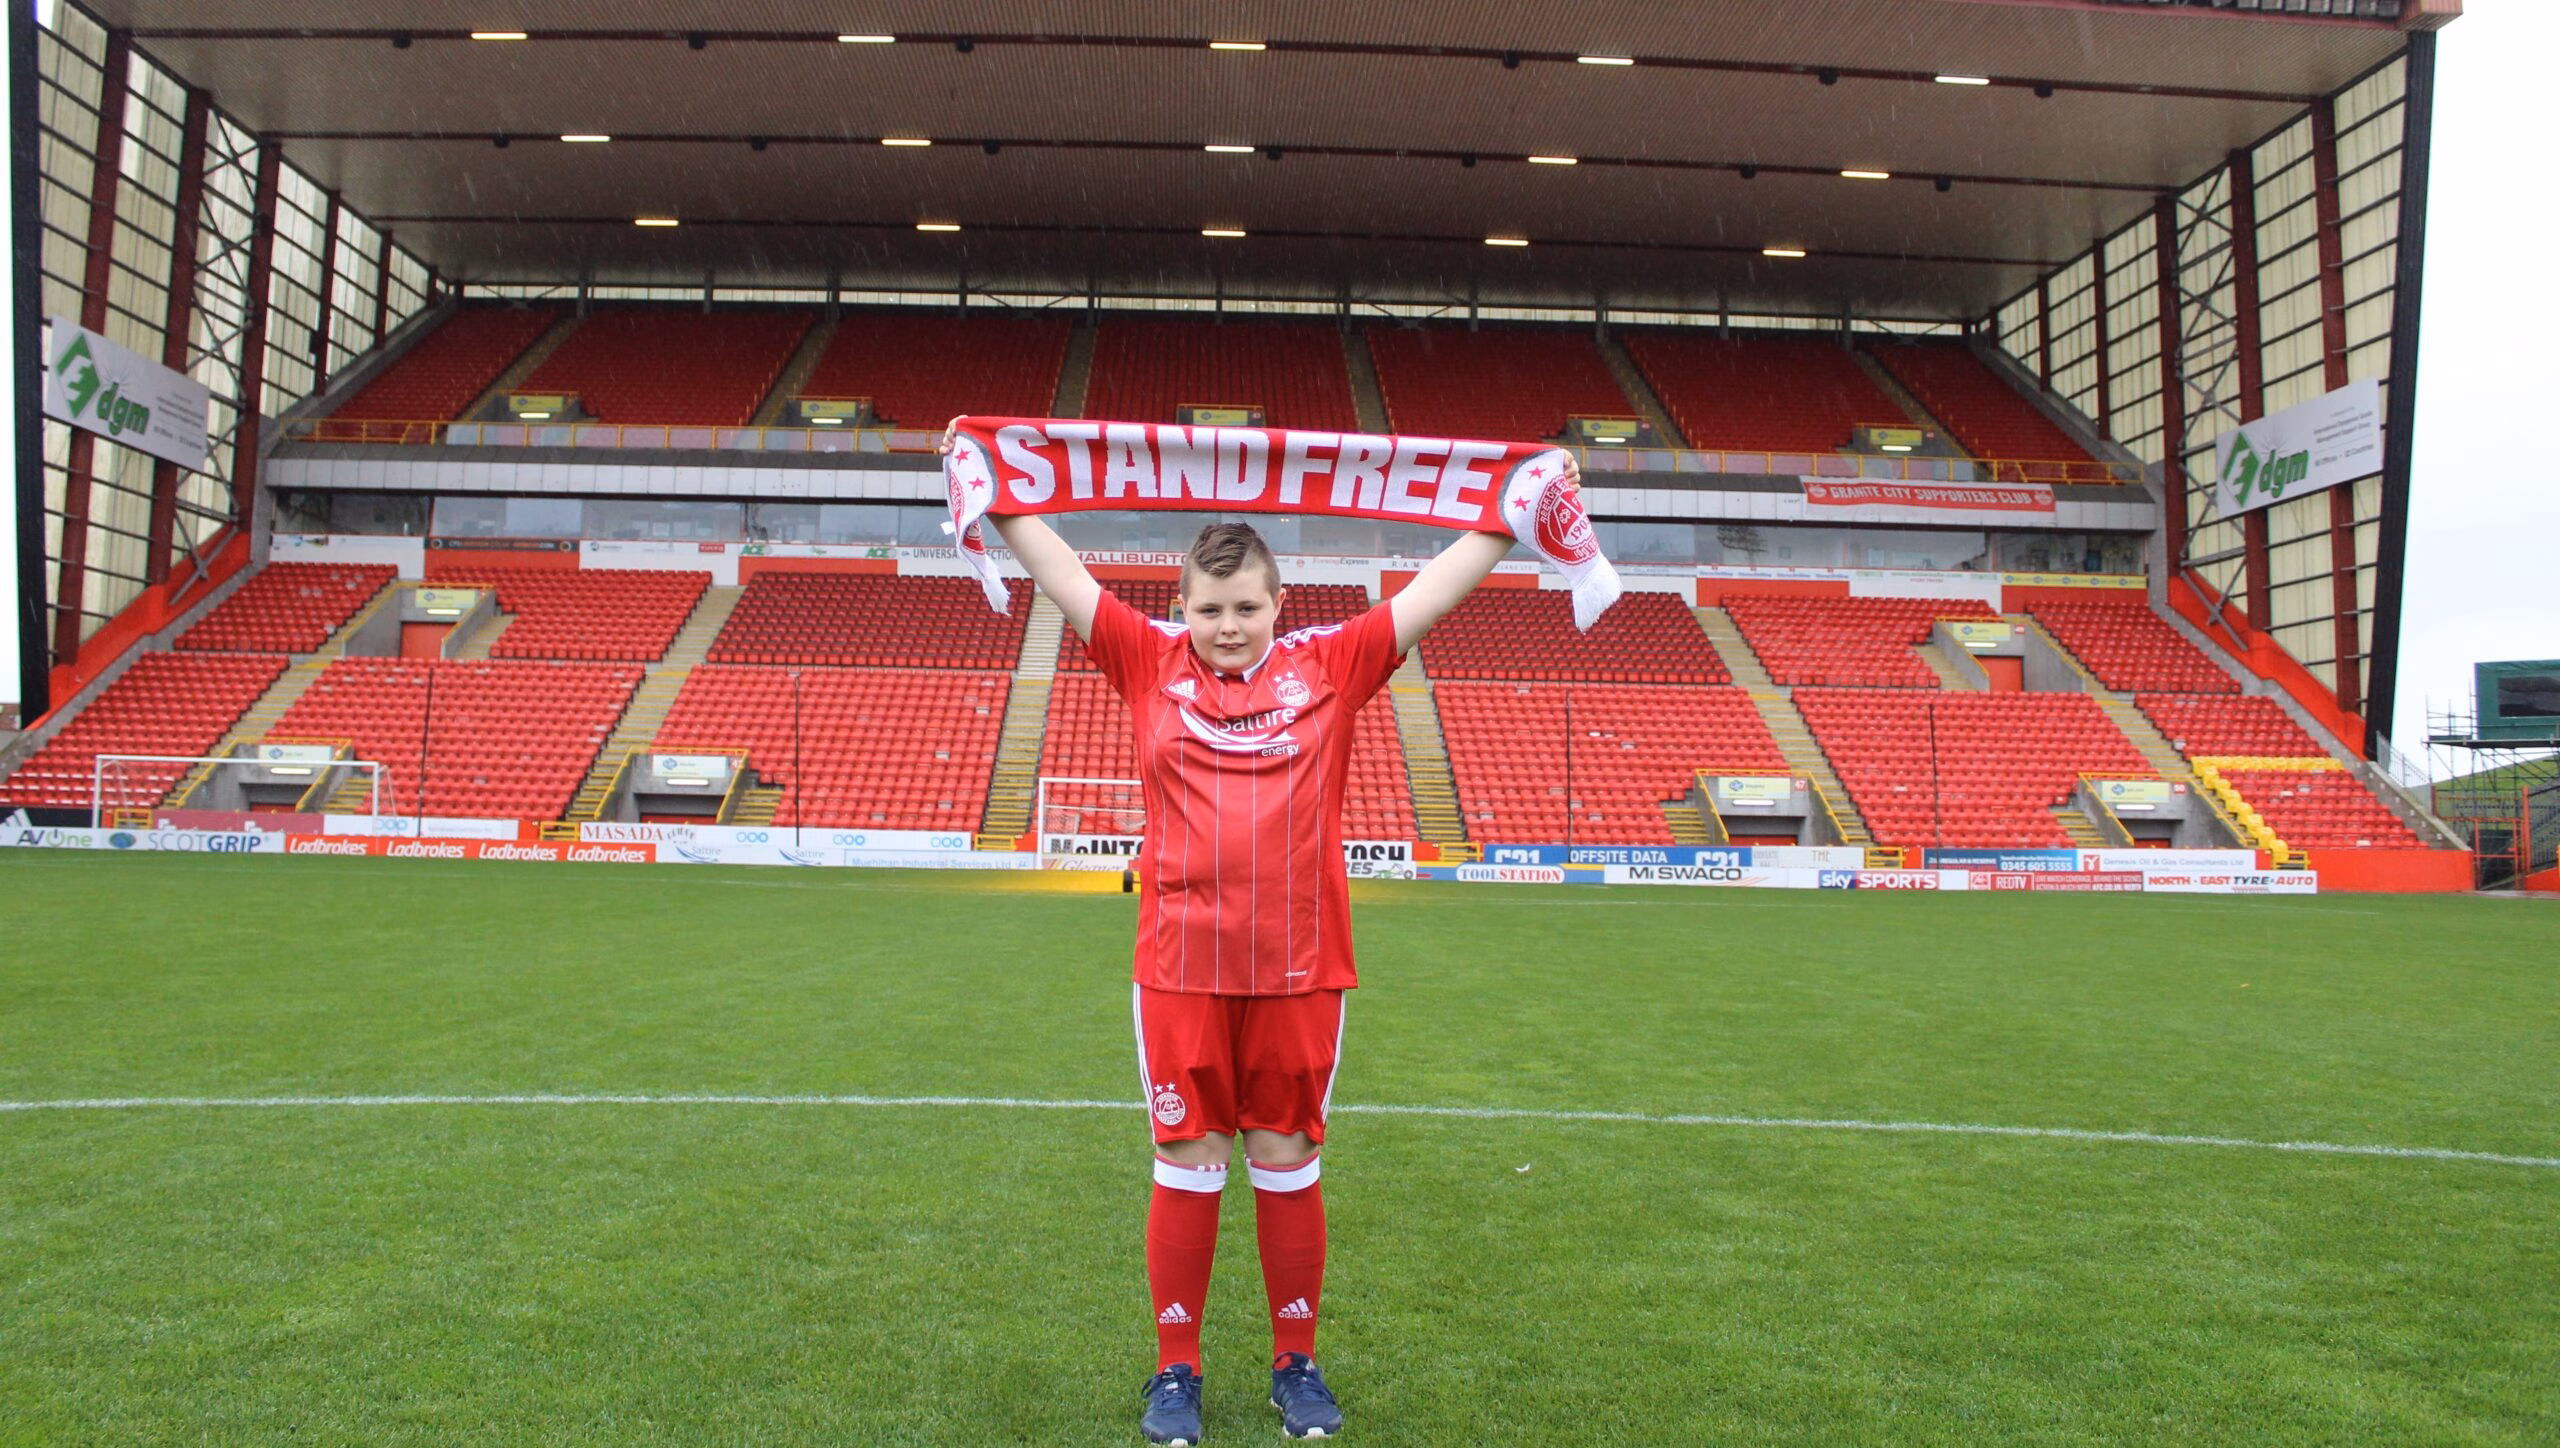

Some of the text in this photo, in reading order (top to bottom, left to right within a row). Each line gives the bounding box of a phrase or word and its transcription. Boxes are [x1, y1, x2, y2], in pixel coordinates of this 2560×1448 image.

[97, 381, 149, 435] dgm
[1000, 424, 1269, 504] STAND
[1278, 431, 1507, 522] FREE
[2259, 449, 2309, 499] dgm
[1830, 486, 2032, 505] GRANITE CITY SUPPORTERS CLUB
[1261, 744, 1300, 757] energy
[583, 825, 664, 841] MASADA
[289, 837, 367, 856] Ladbrokes
[387, 840, 465, 859] Ladbrokes
[479, 842, 558, 862] Ladbrokes
[567, 845, 646, 863] Ladbrokes
[1570, 850, 1668, 863] OFFSITE DATA
[1460, 867, 1562, 882] TOOLSTATION
[1658, 868, 1742, 881] SWACO
[1821, 871, 1937, 889] sky SPORTS
[2148, 876, 2314, 885] NORTH EAST TYRE AUTO
[1158, 1316, 1192, 1324] adidas
[1278, 1311, 1313, 1320] adidas
